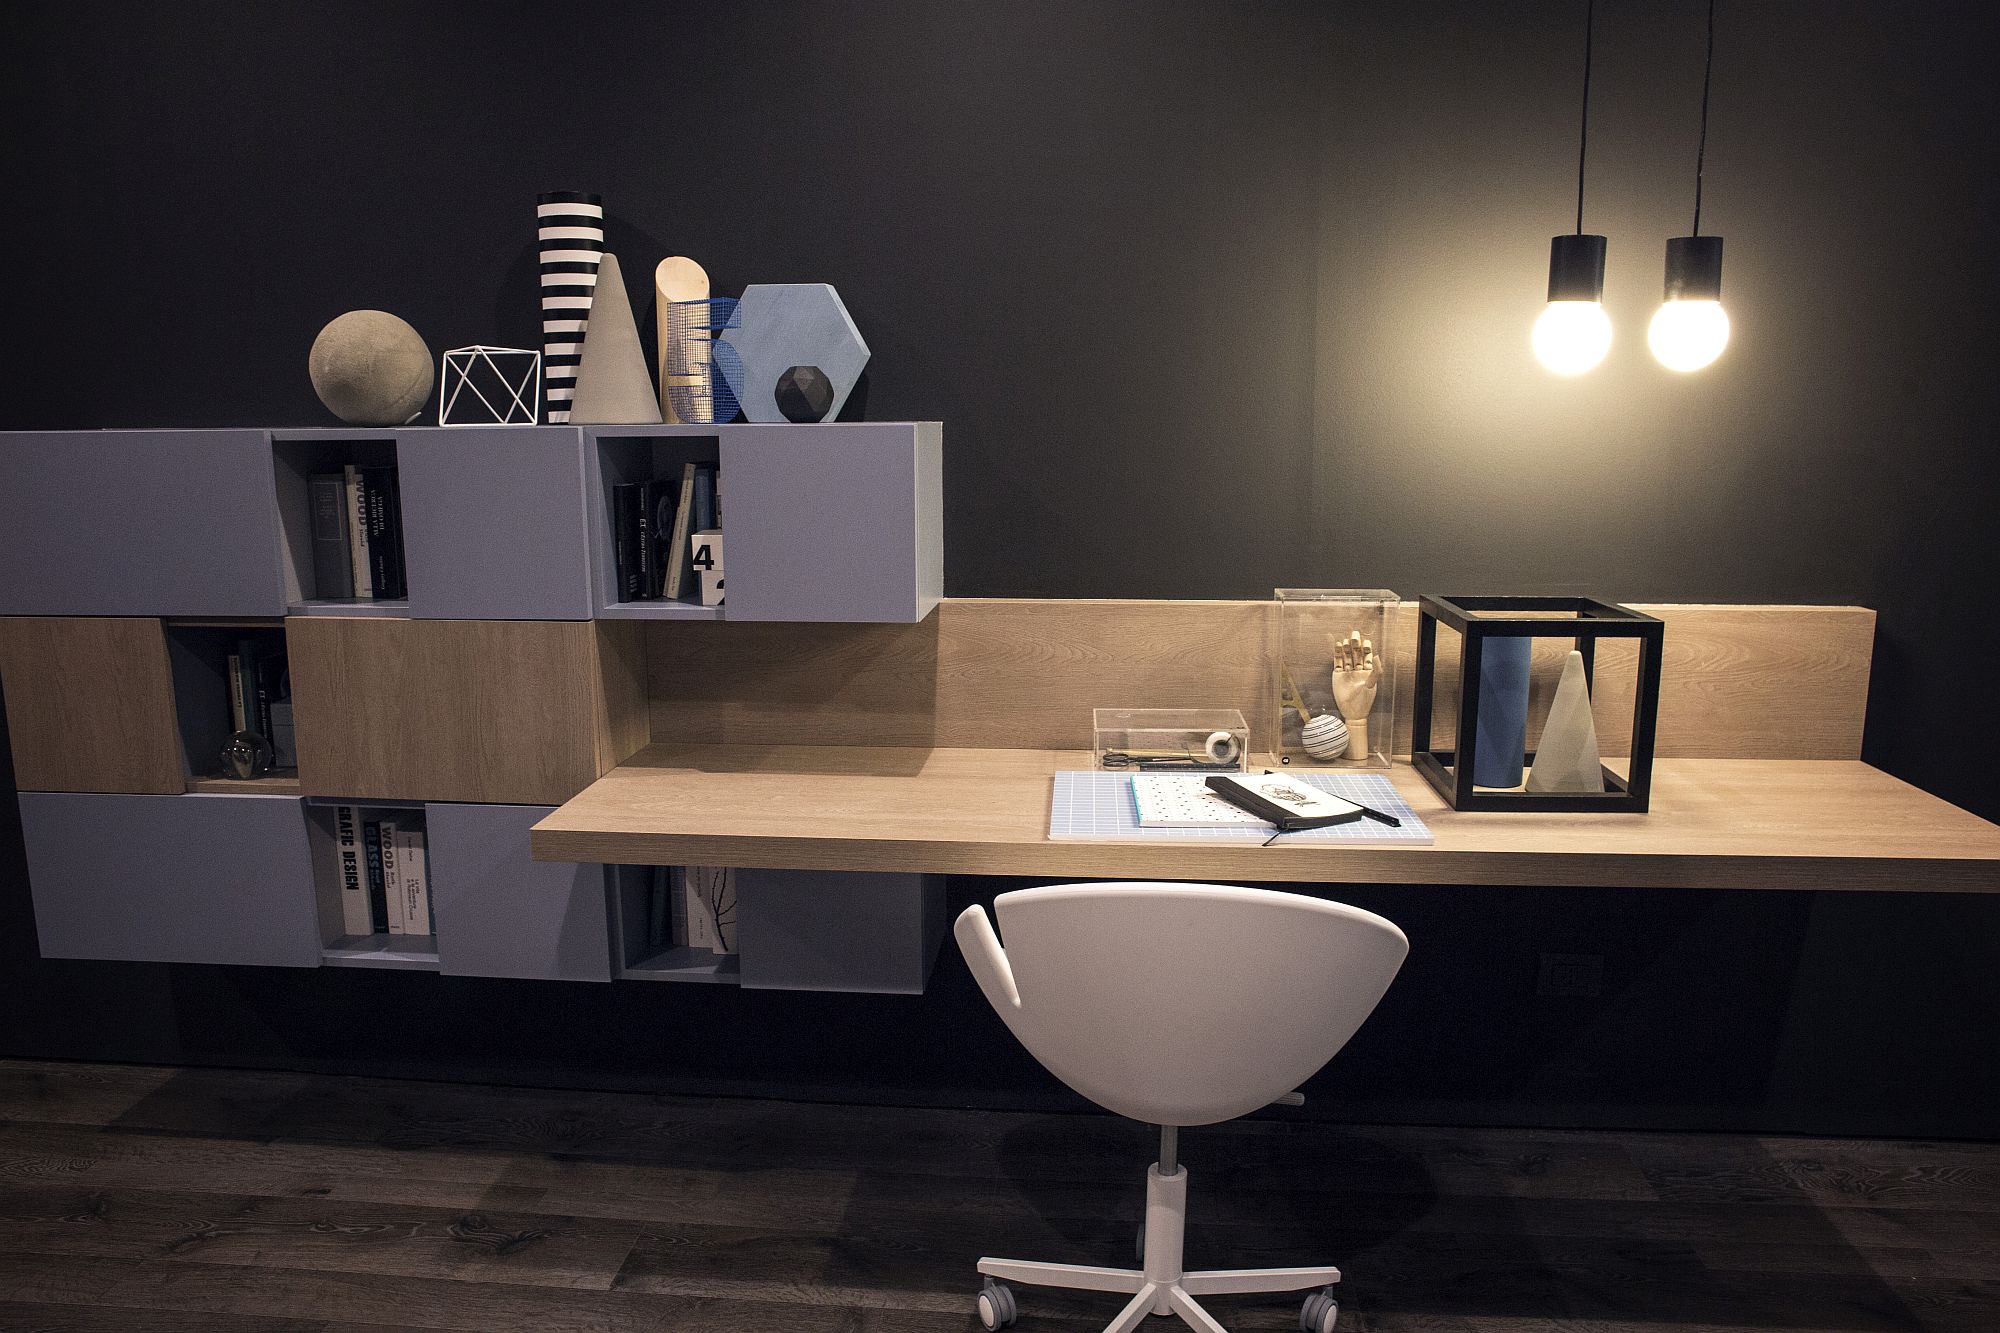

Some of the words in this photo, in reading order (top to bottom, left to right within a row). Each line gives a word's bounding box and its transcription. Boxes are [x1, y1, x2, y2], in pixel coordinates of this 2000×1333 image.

[356, 481, 366, 526] WOOD
[693, 545, 714, 570] 4
[338, 807, 355, 846] GRAFIC
[366, 826, 380, 869] GLASS
[382, 827, 394, 869] WOOD
[343, 851, 359, 890] DESIGN
